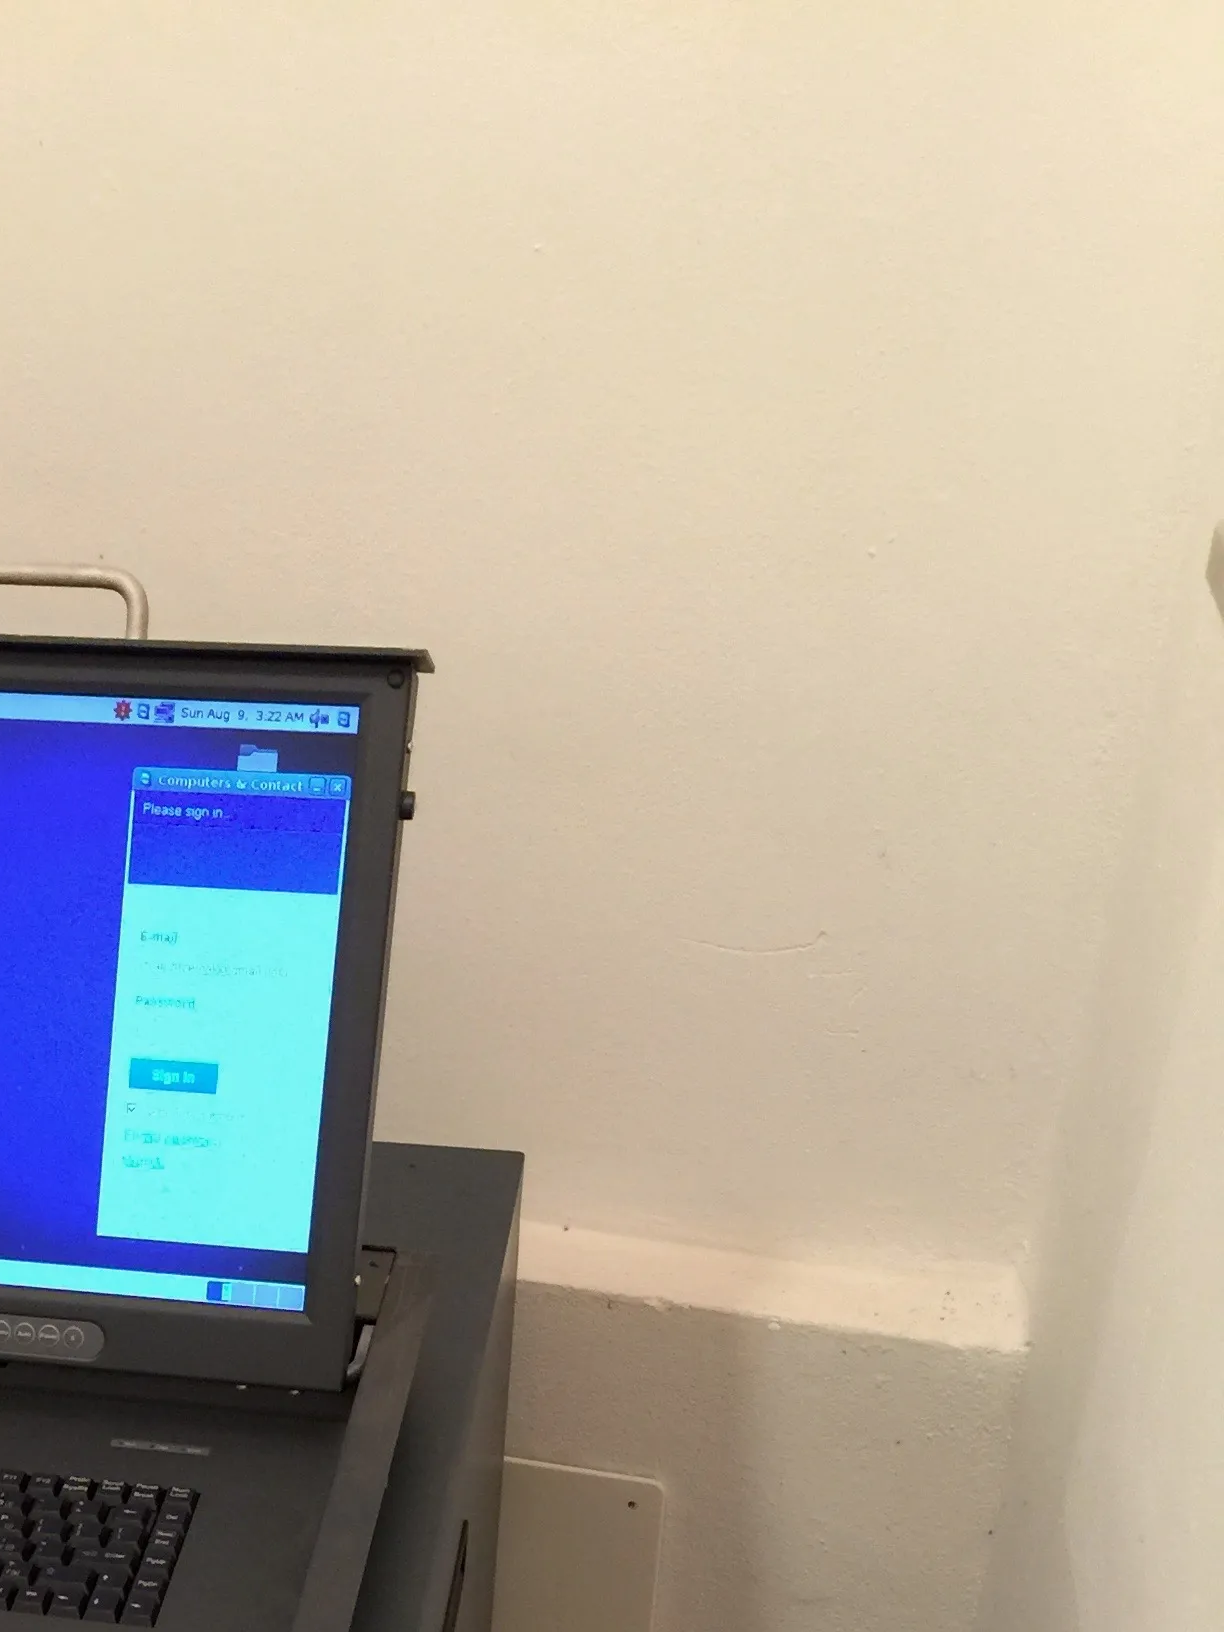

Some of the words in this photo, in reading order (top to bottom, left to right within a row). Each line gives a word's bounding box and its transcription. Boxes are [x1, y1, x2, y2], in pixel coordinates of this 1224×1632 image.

[180, 706, 204, 720] Sun
[207, 708, 230, 722] Aug
[284, 712, 305, 723] AM
[158, 775, 231, 790] Computers
[142, 801, 182, 818] Please
[185, 806, 206, 821] sign
[152, 1068, 180, 1085] Sign
